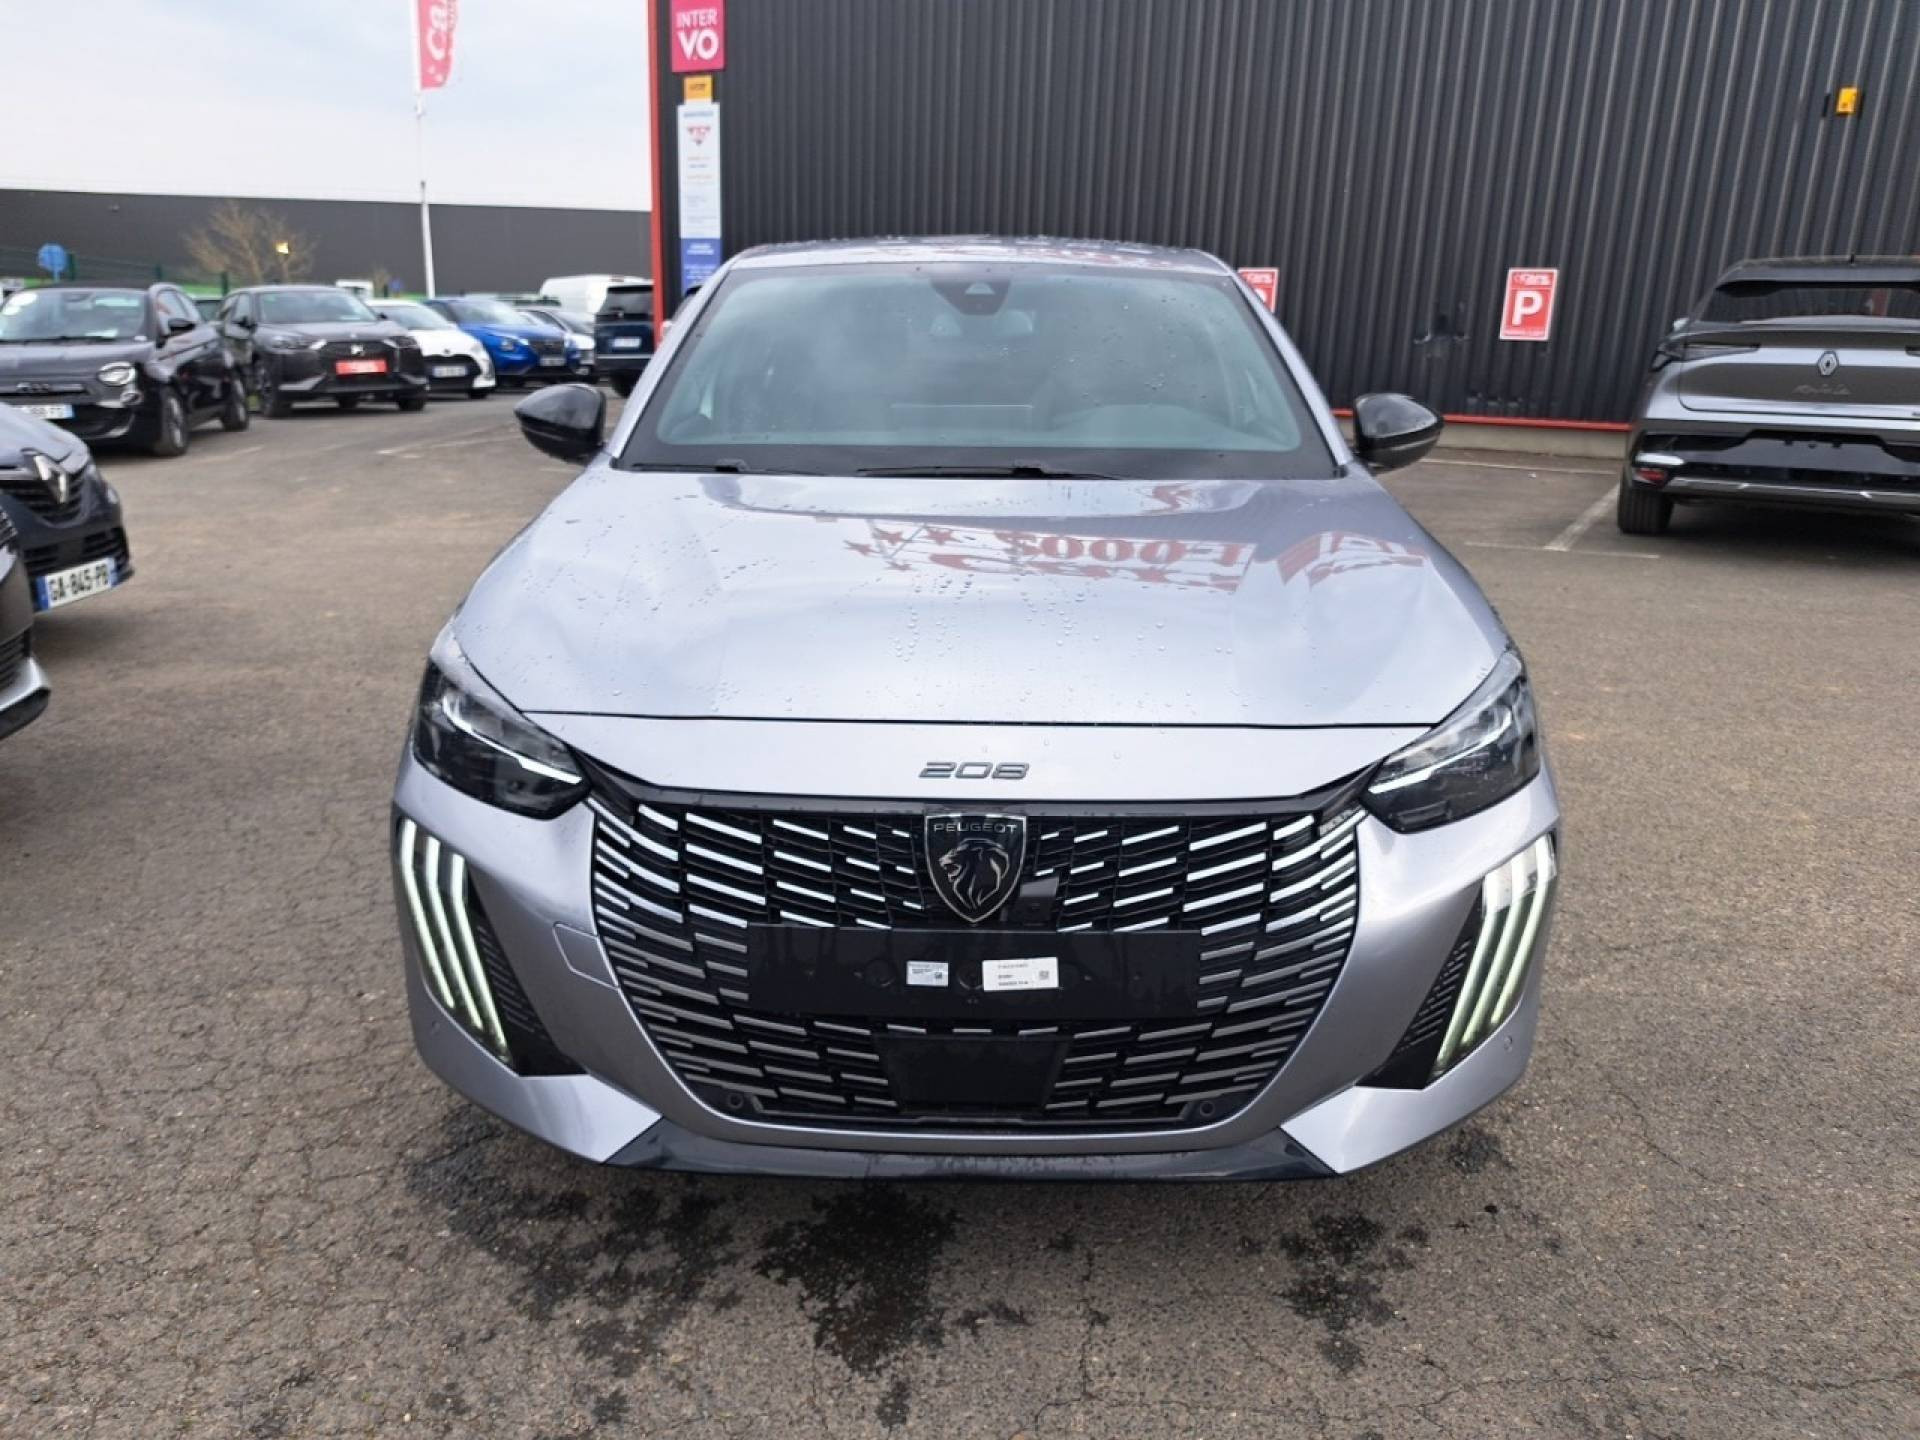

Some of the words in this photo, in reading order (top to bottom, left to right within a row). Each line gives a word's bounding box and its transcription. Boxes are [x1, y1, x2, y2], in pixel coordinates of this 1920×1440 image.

[676, 8, 718, 29] INTER
[1511, 289, 1544, 326] P
[918, 761, 1030, 780] 208
[933, 822, 1018, 833] PEUGEOT
